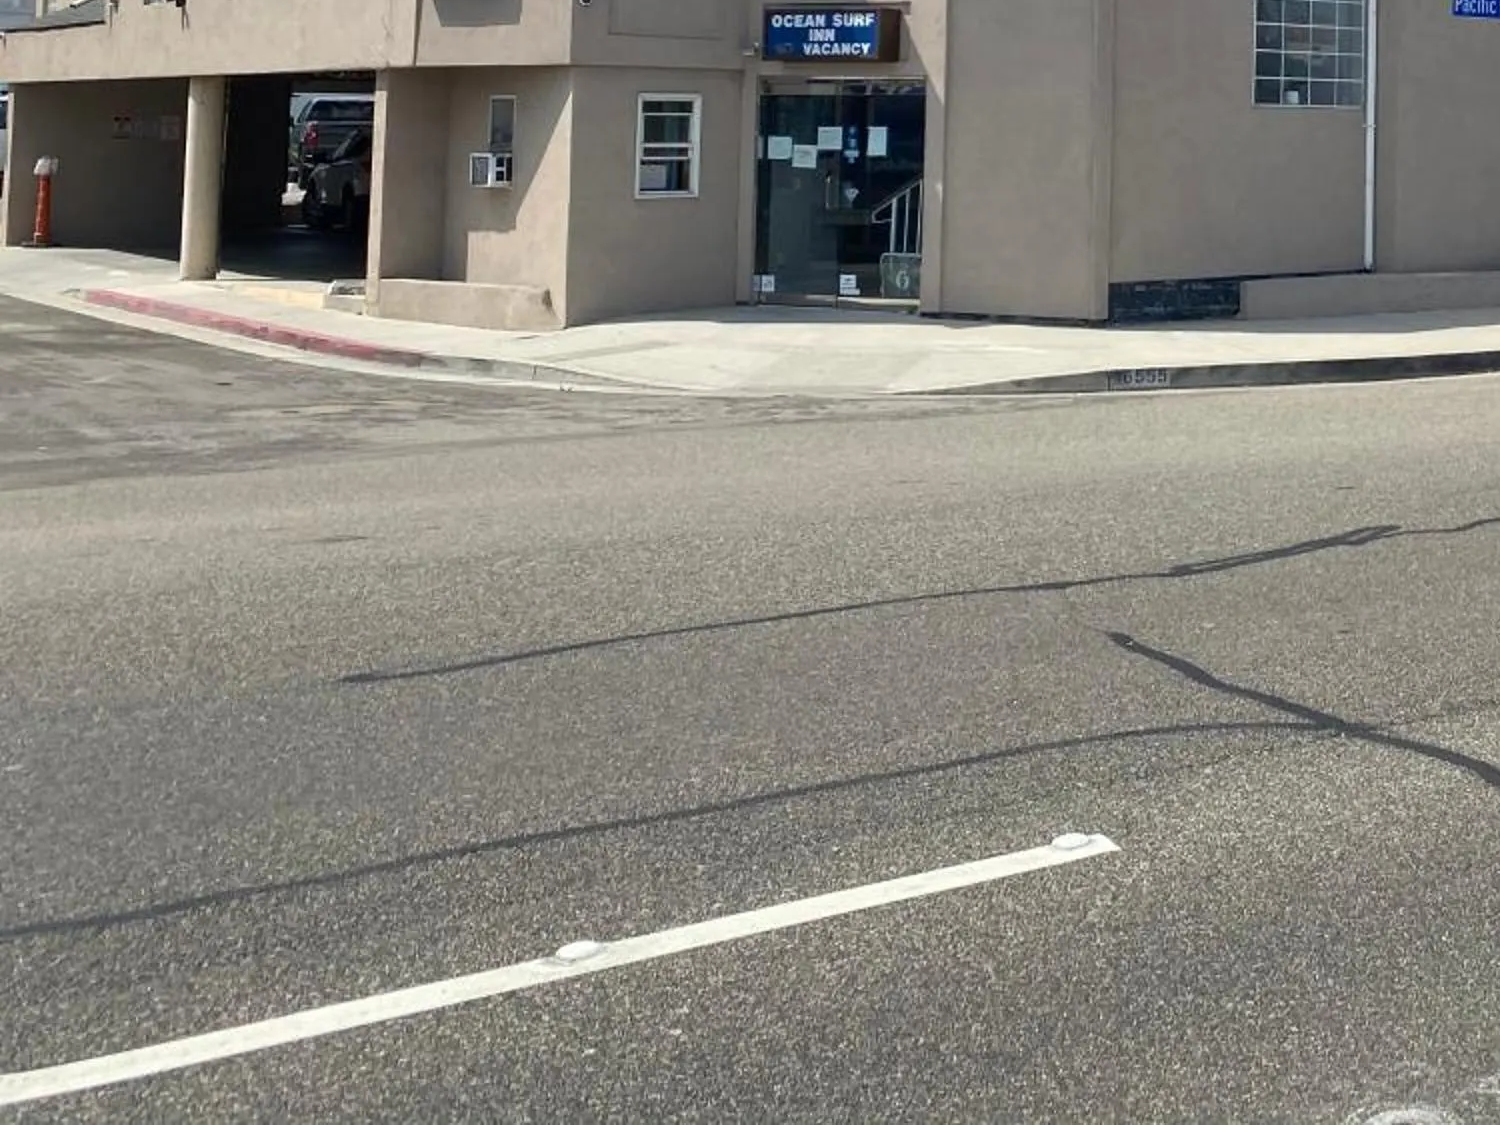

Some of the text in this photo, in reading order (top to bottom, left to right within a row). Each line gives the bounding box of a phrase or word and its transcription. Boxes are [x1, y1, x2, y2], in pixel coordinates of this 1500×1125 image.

[771, 13, 876, 28] OCEAN SURF
[808, 28, 836, 42] INN
[803, 42, 872, 56] VACANCY
